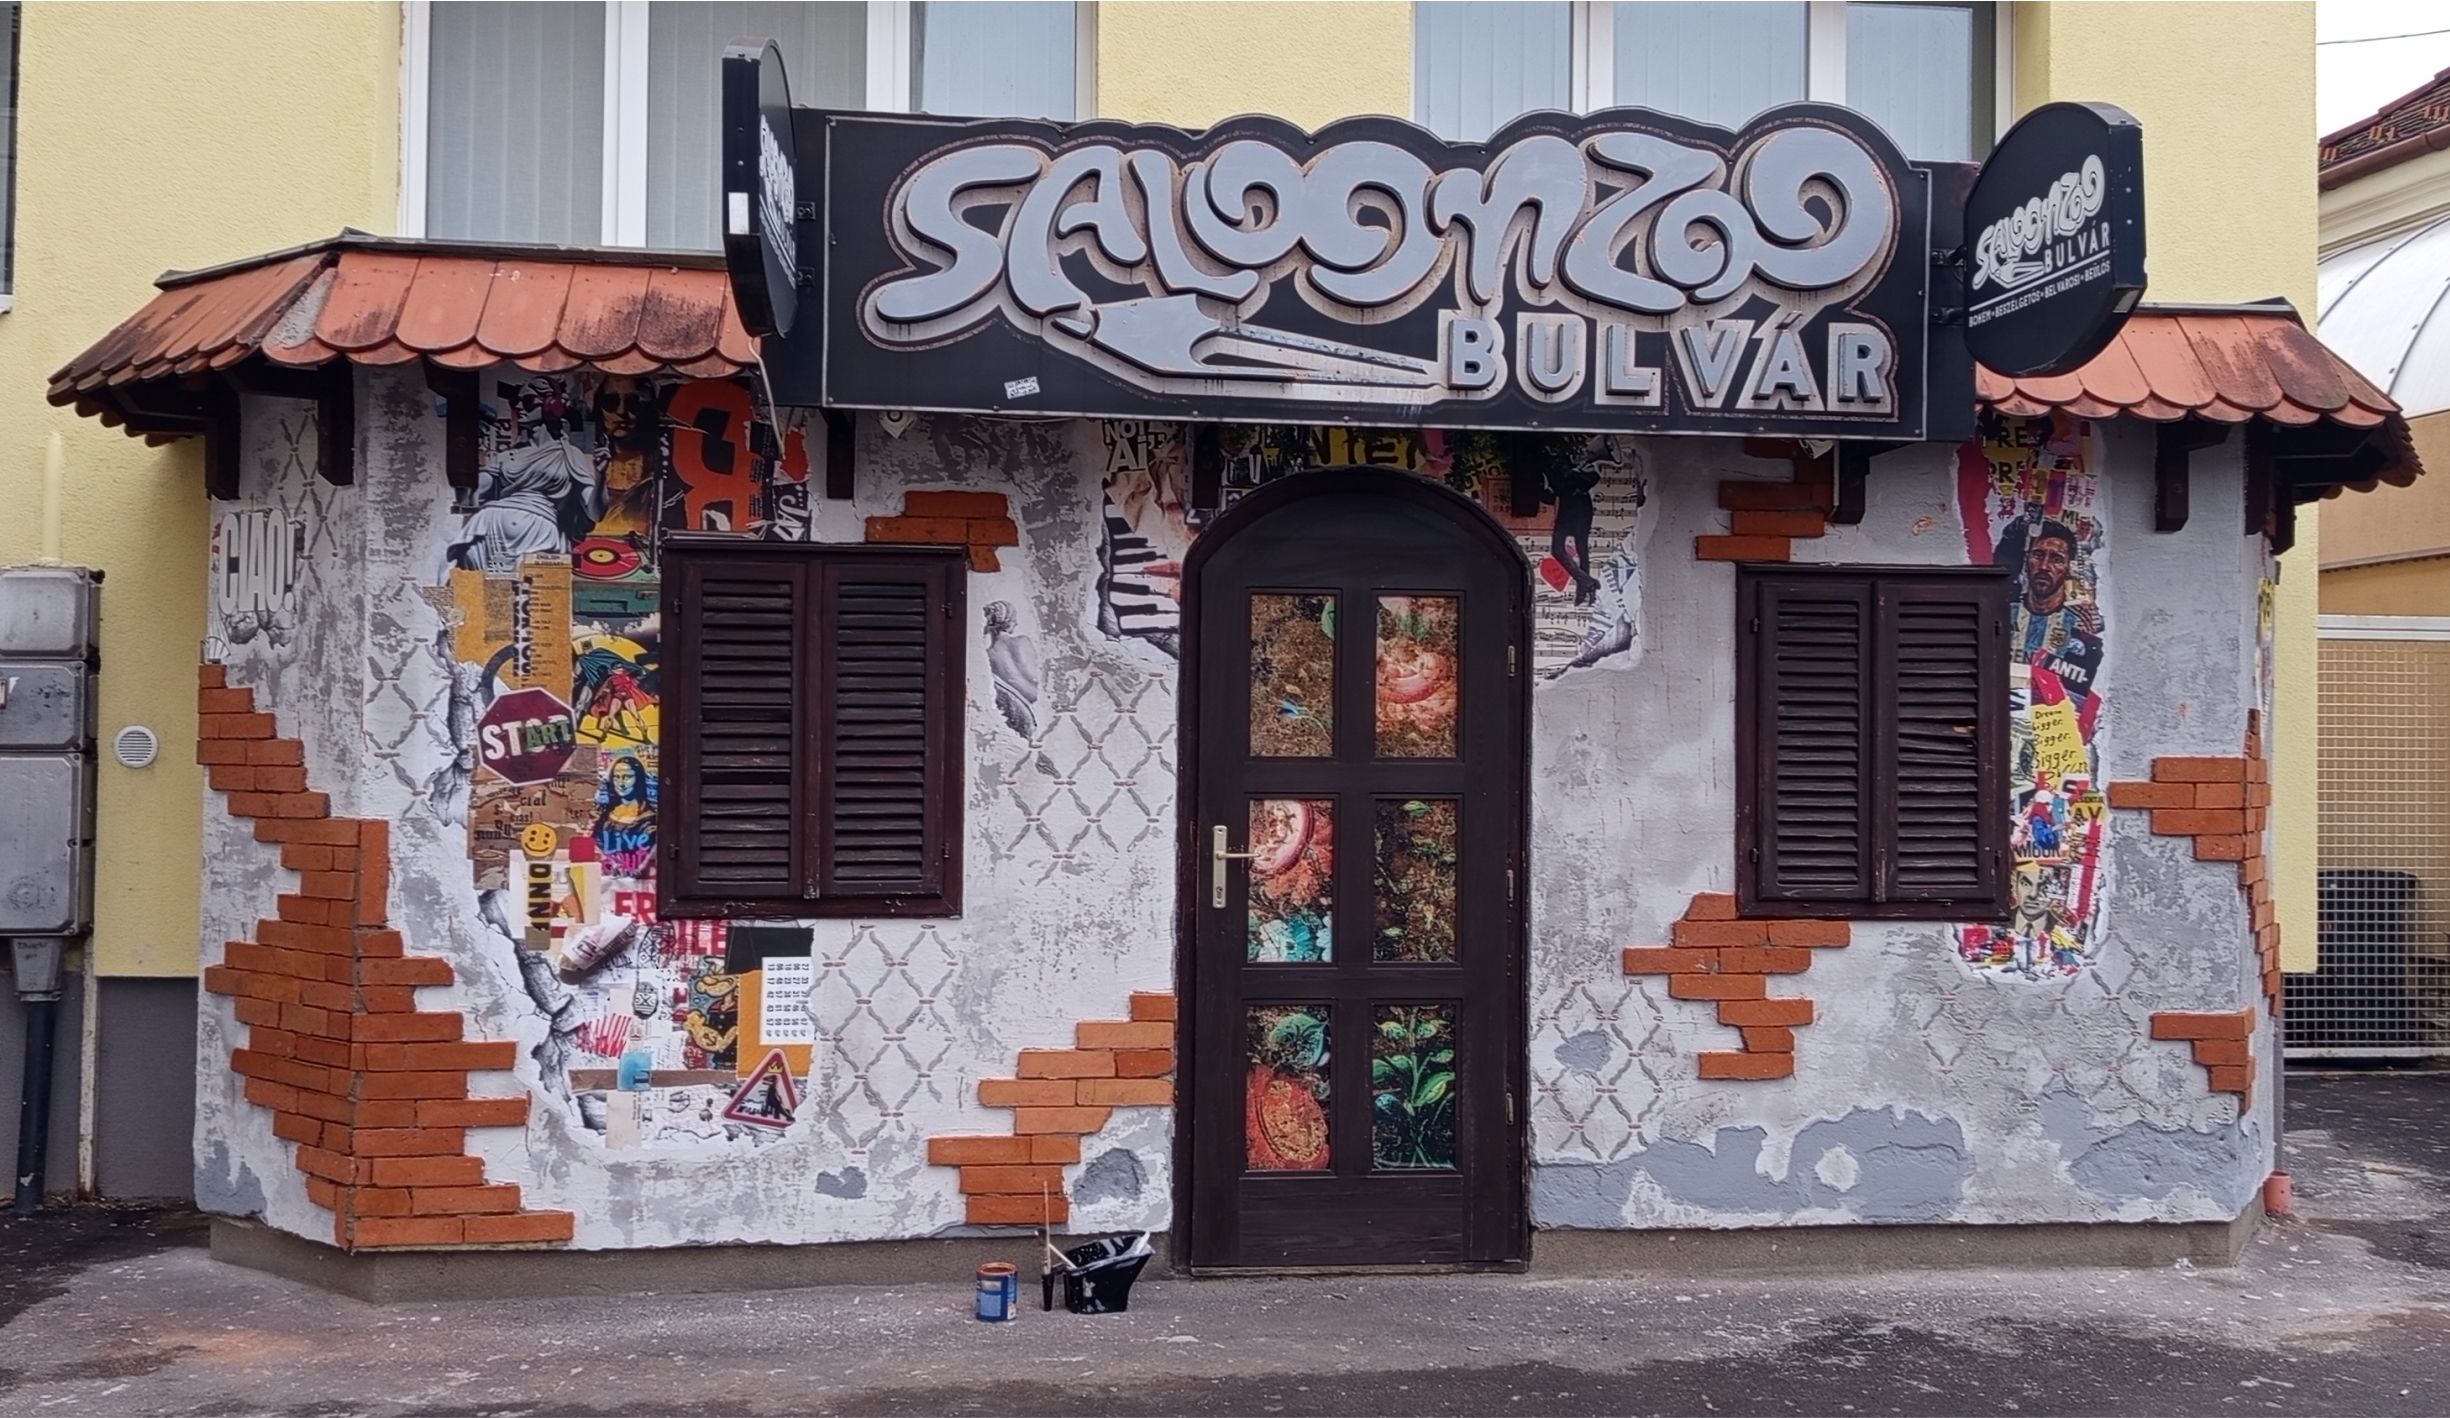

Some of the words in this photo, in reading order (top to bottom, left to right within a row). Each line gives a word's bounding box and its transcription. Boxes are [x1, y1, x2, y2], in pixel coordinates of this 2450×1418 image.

[2044, 222, 2110, 273] BULVÁR
[1448, 312, 1895, 403] BULVÁR
[219, 508, 295, 615] CIAO!
[2049, 658, 2088, 684] ANTI-
[602, 829, 651, 854] Live
